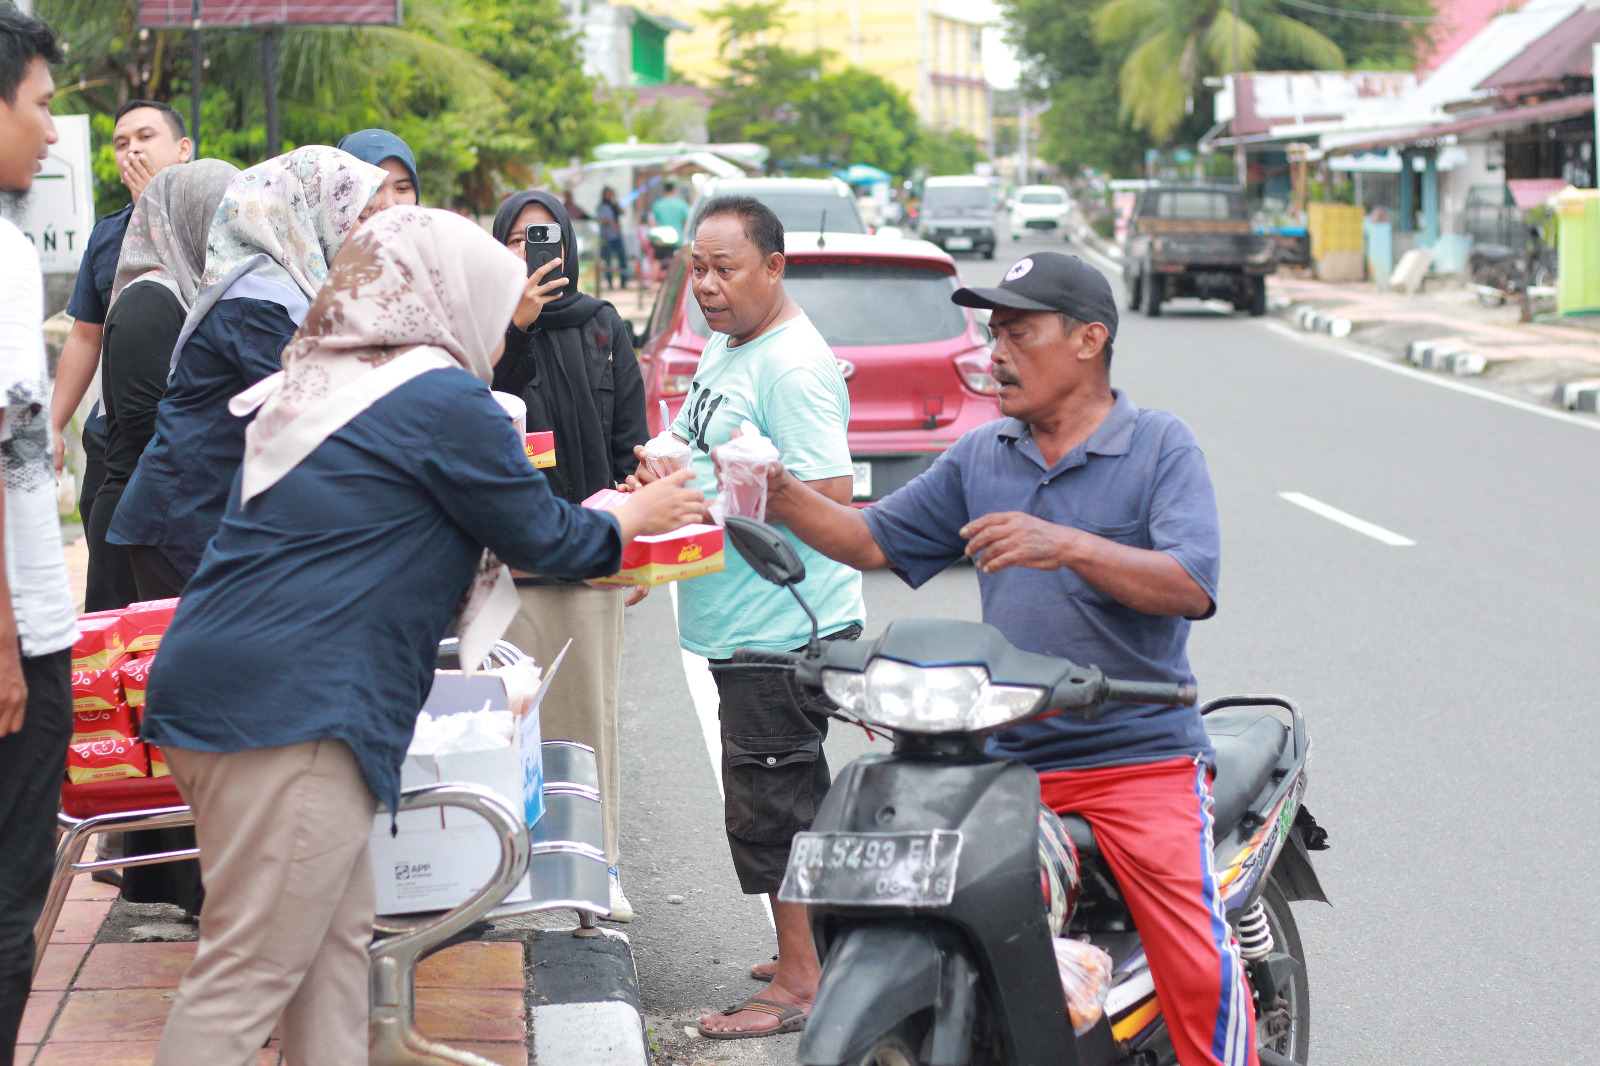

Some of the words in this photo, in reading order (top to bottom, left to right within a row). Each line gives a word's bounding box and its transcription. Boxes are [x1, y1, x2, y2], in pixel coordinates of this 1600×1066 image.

[794, 838, 823, 868] BA
[830, 838, 897, 868] 5493
[411, 864, 431, 873] APP
